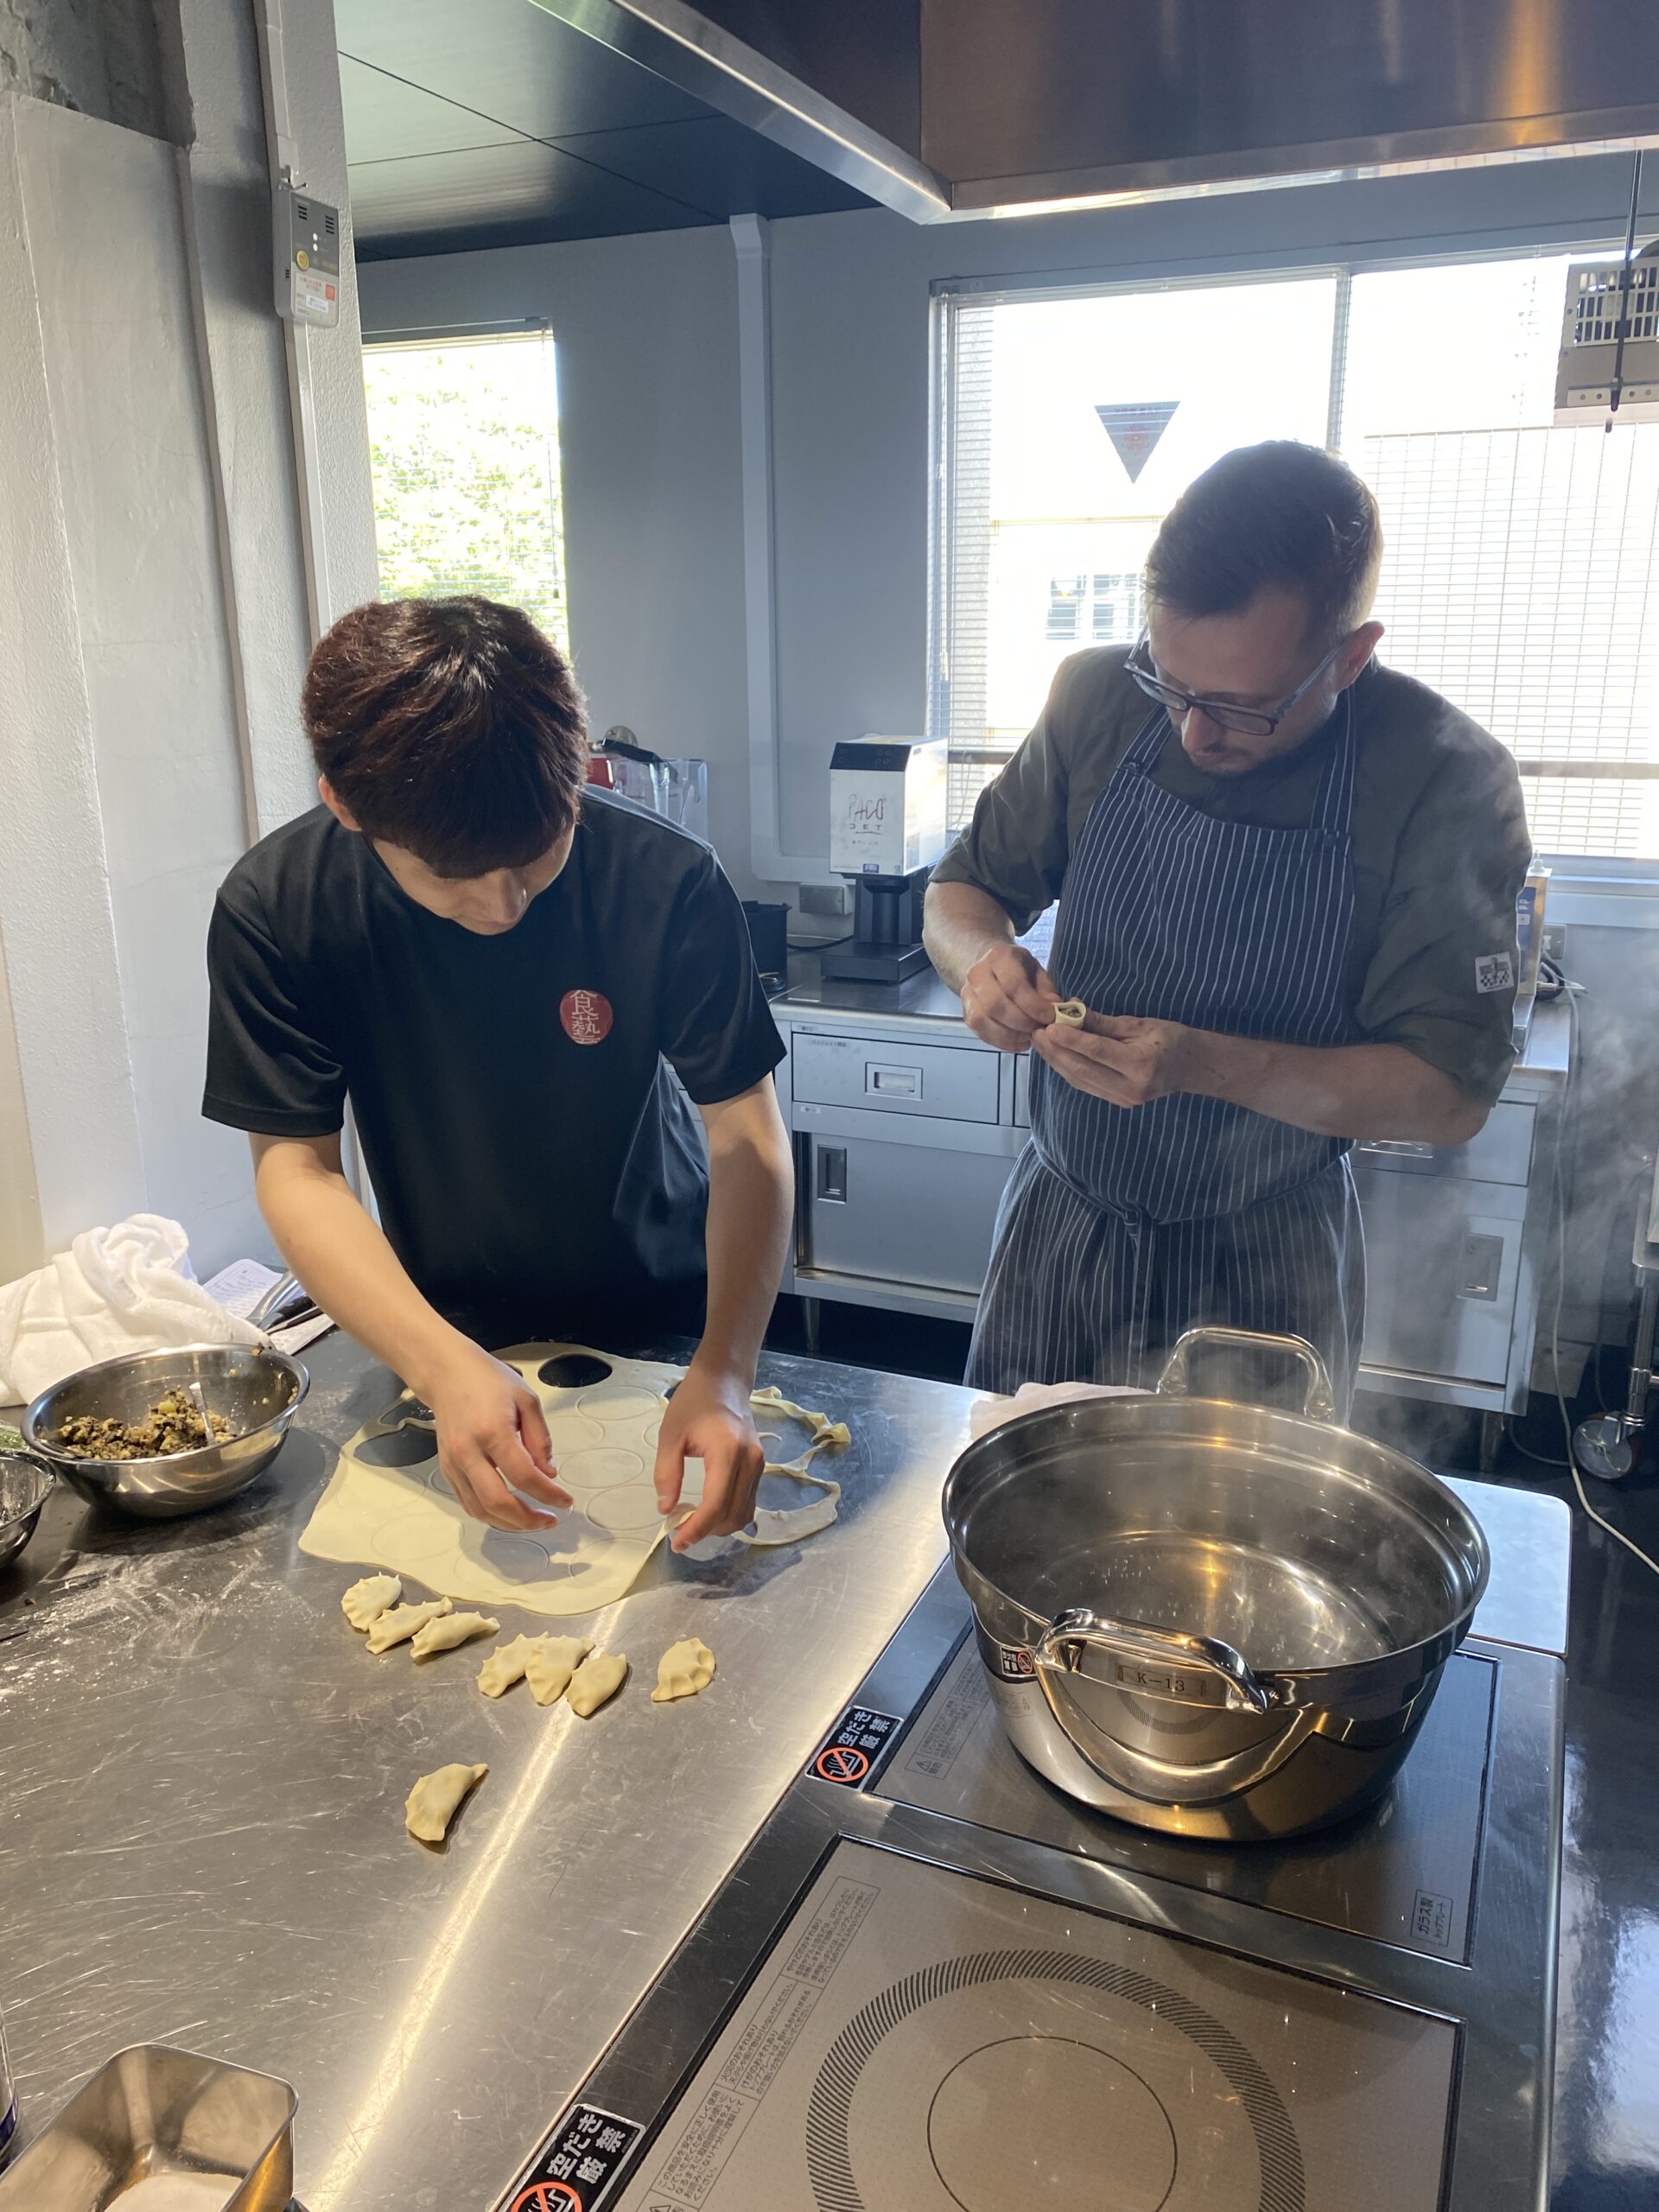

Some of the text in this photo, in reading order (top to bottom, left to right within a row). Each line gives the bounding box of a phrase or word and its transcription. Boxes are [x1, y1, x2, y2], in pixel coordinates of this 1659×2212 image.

[838, 1712, 872, 1747] 空だき
[859, 1715, 891, 1750] 厳禁
[719, 2024, 759, 2082] 火災のおそれあり
[739, 2030, 779, 2088] けがのおそれあり
[546, 2113, 603, 2180] 空だき
[575, 2126, 626, 2185] 厳禁
